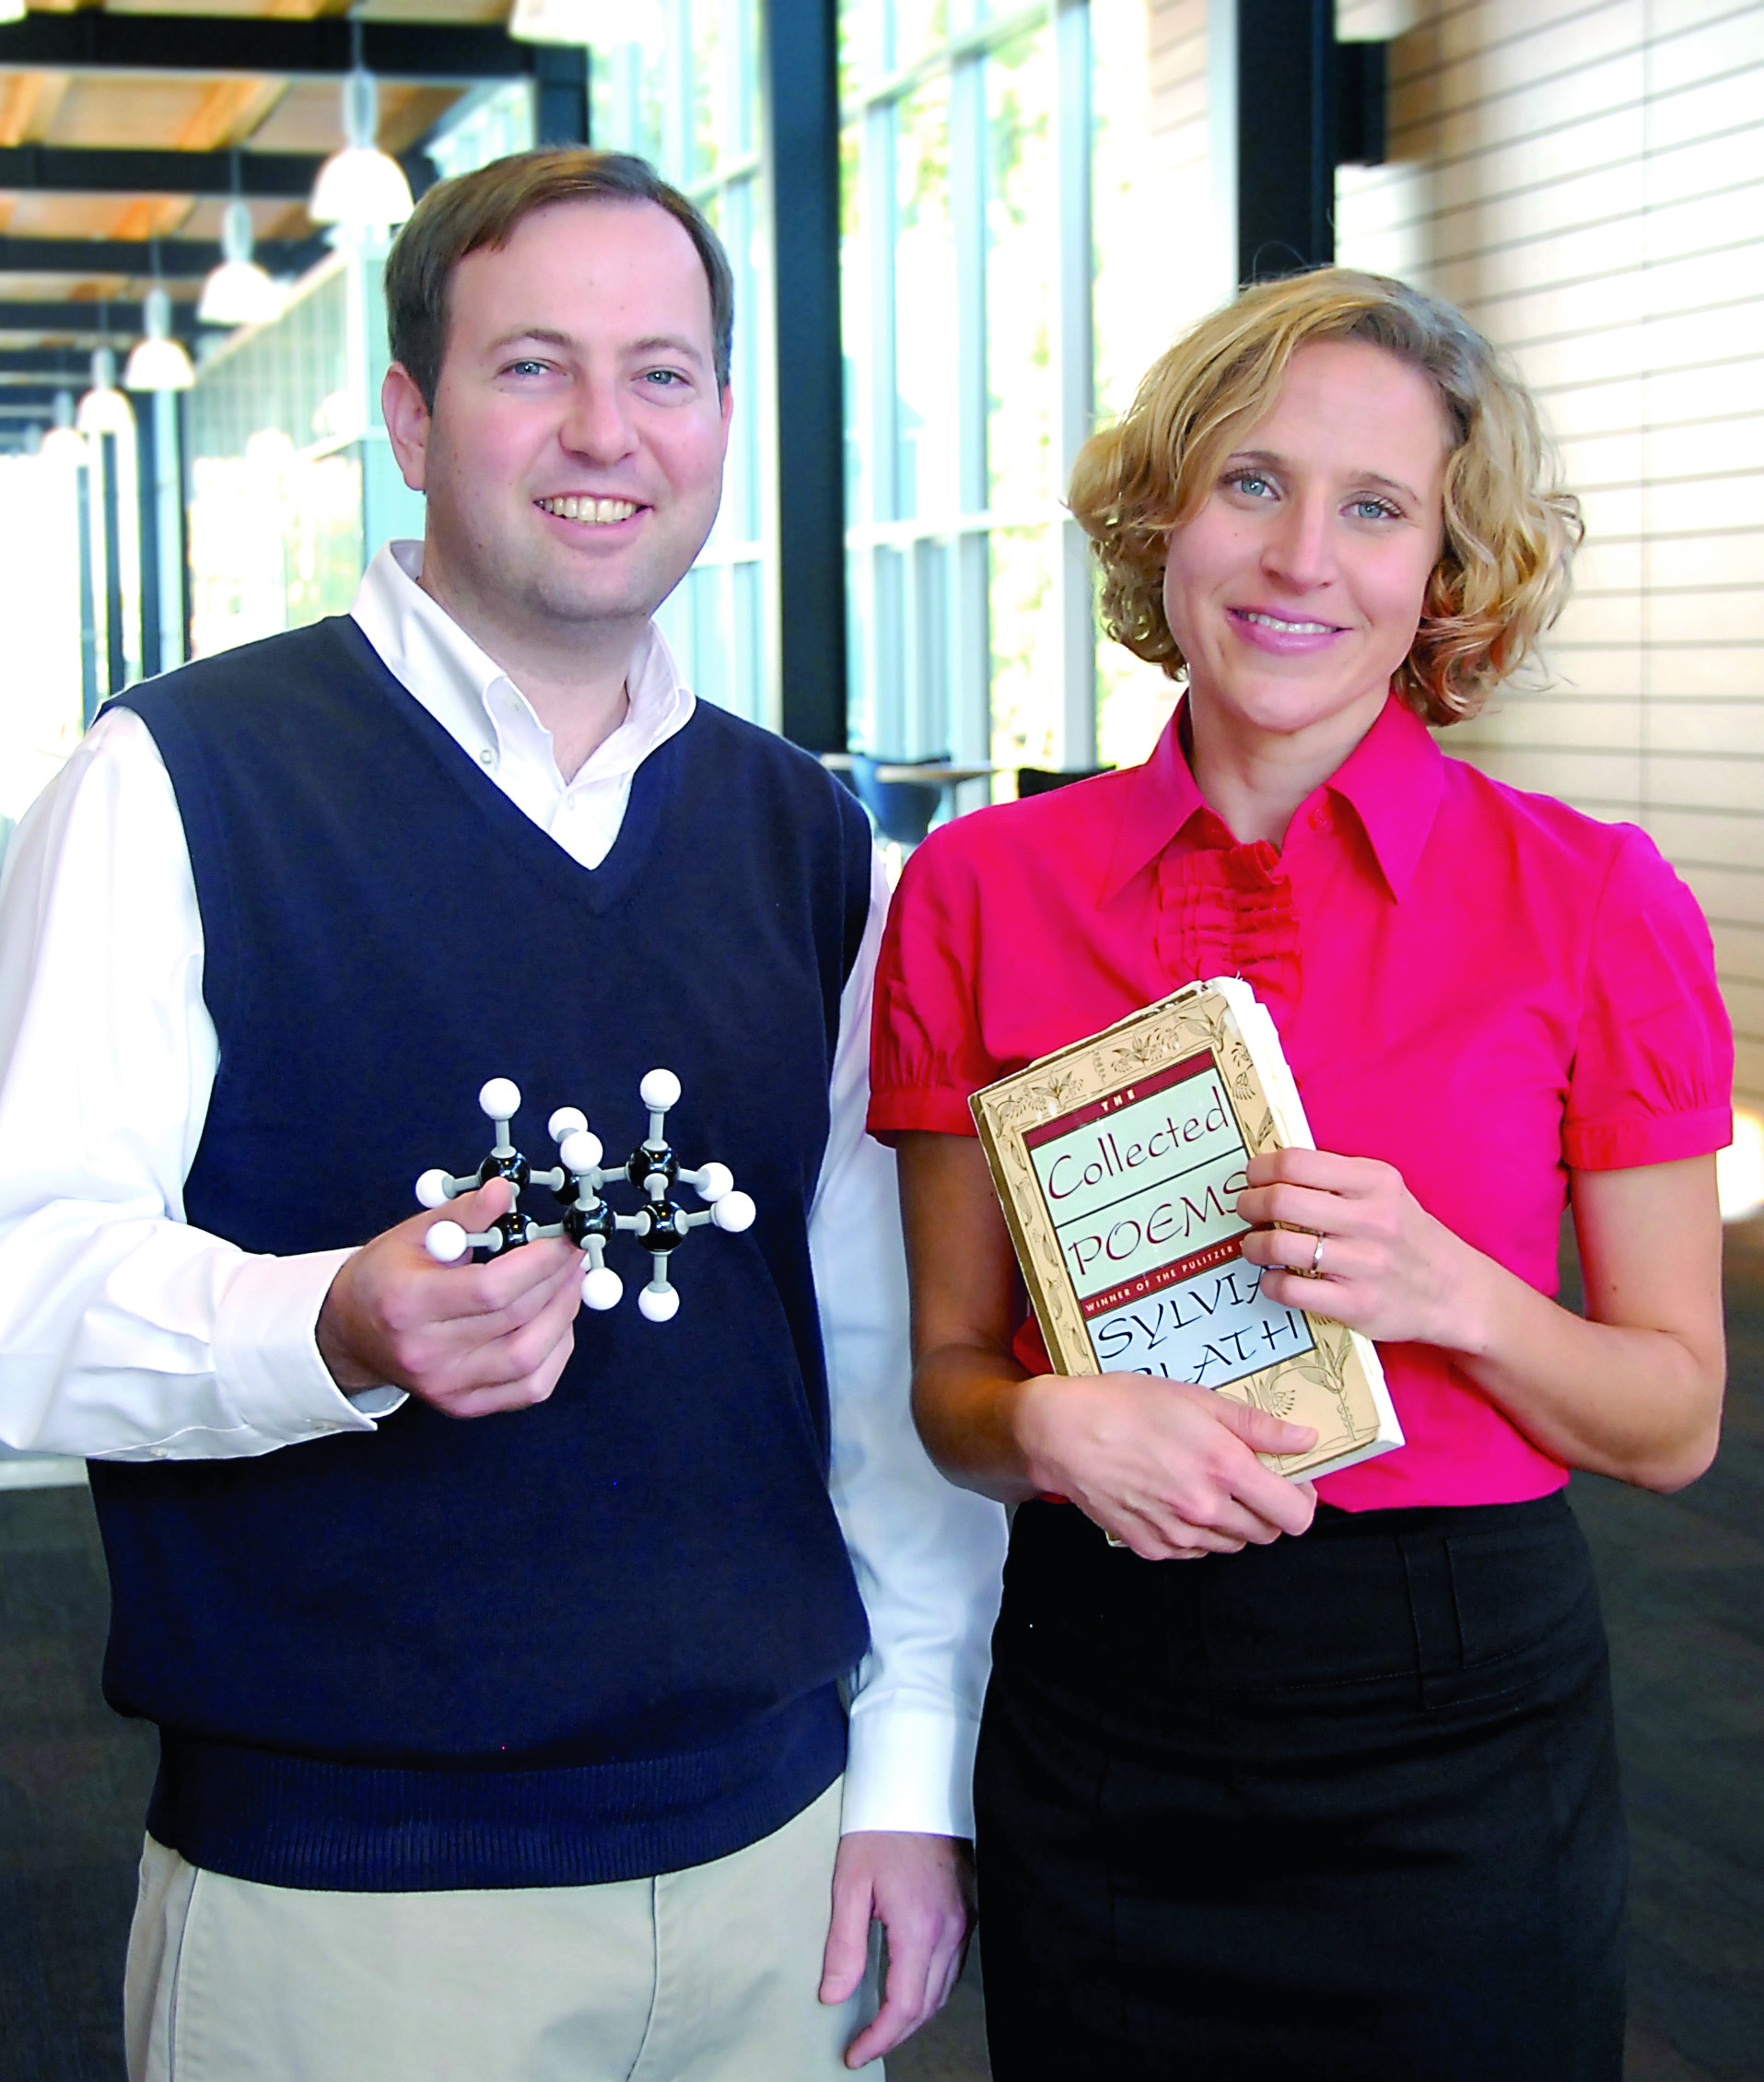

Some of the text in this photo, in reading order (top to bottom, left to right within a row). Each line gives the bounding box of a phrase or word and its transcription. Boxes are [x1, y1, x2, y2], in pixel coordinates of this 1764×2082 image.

[1101, 1089, 1136, 1111] THE
[1048, 1085, 1229, 1199] Collected
[1068, 1170, 1249, 1276] POEMS
[1085, 1246, 1233, 1312] WINNER OF THE PULITZER
[1131, 1310, 1299, 1385] ATH
